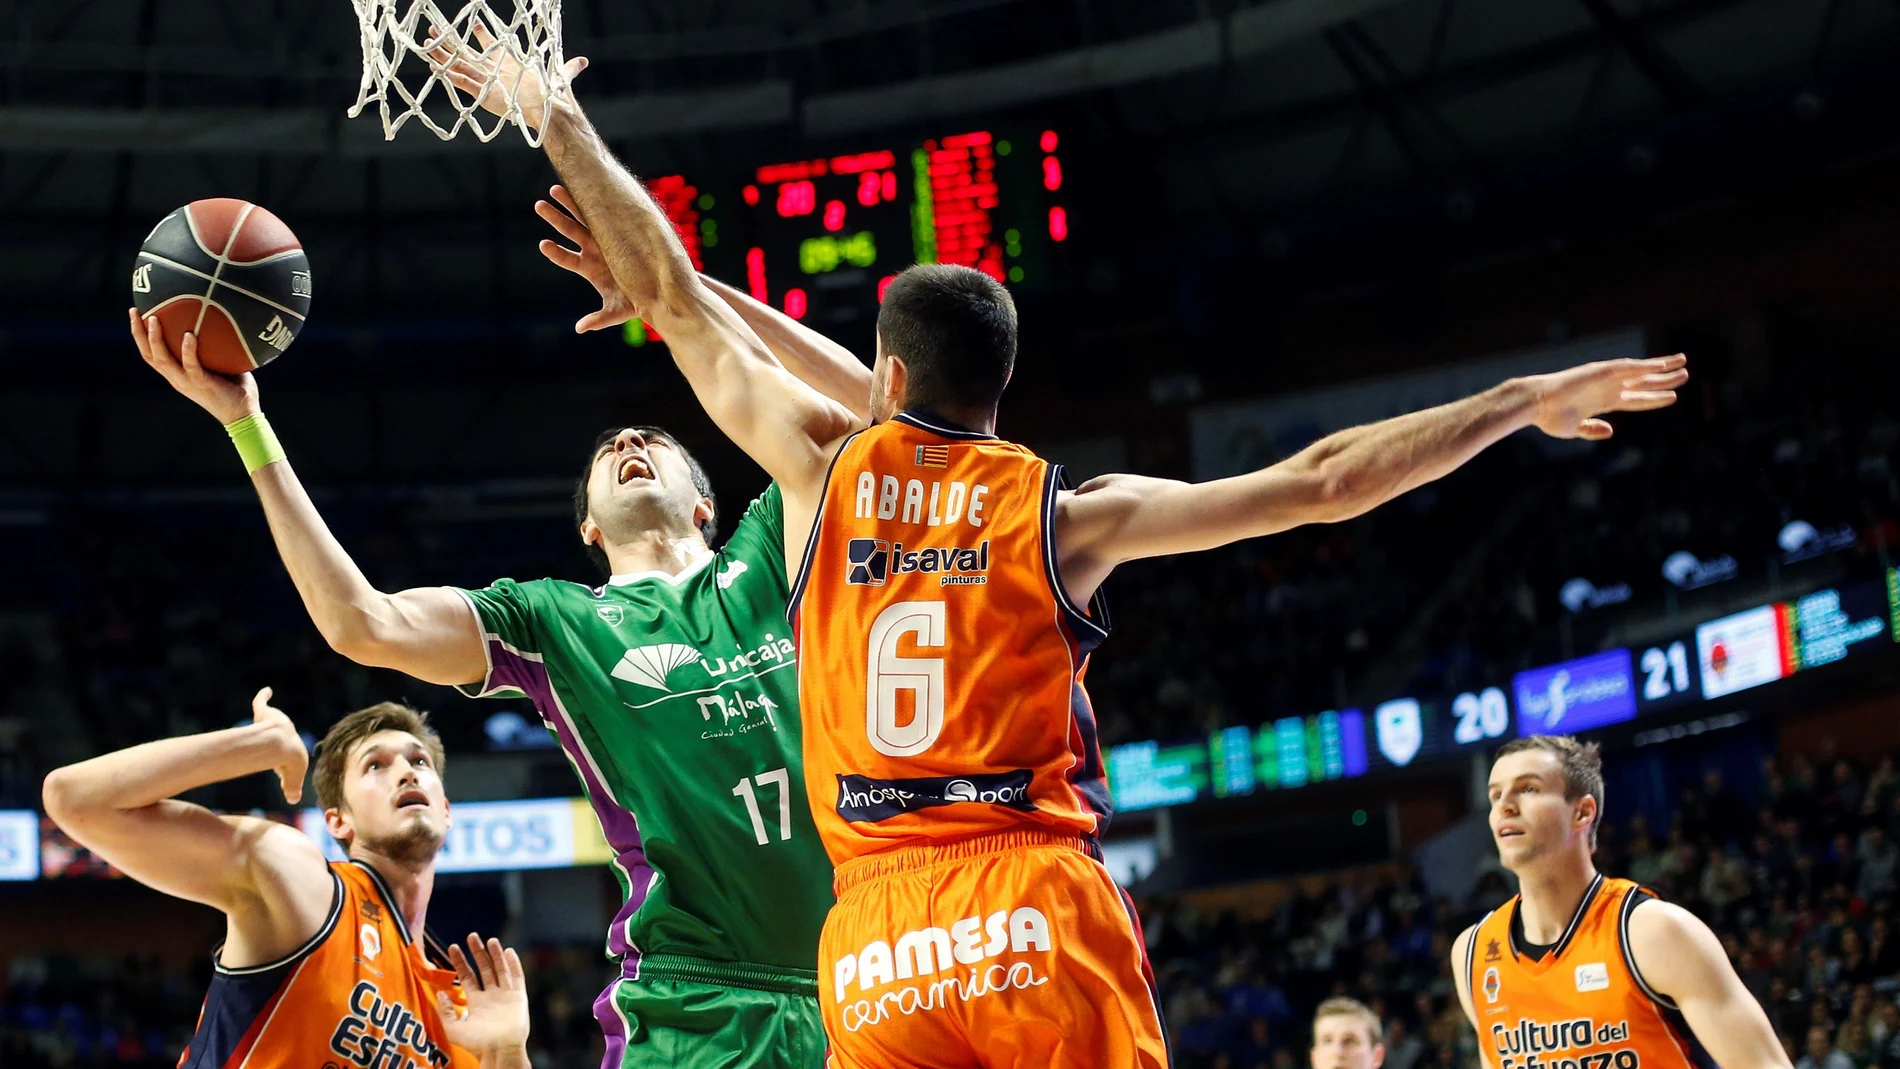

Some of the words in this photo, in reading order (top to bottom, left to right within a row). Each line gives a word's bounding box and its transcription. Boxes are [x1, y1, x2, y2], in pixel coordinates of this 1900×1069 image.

[855, 471, 989, 528] ABALDE
[891, 540, 990, 574] isaval
[940, 574, 988, 587] pinturas
[699, 633, 796, 677] Uncaja
[866, 601, 946, 757] 6
[1640, 640, 1690, 700] 21
[1451, 686, 1509, 744] 20
[732, 767, 792, 845] 17
[443, 814, 555, 857] TOS
[834, 906, 1051, 1004] PAMESA
[842, 961, 1049, 1032] ceramica
[1491, 1017, 1593, 1056] Cultura
[1596, 1021, 1628, 1044] del
